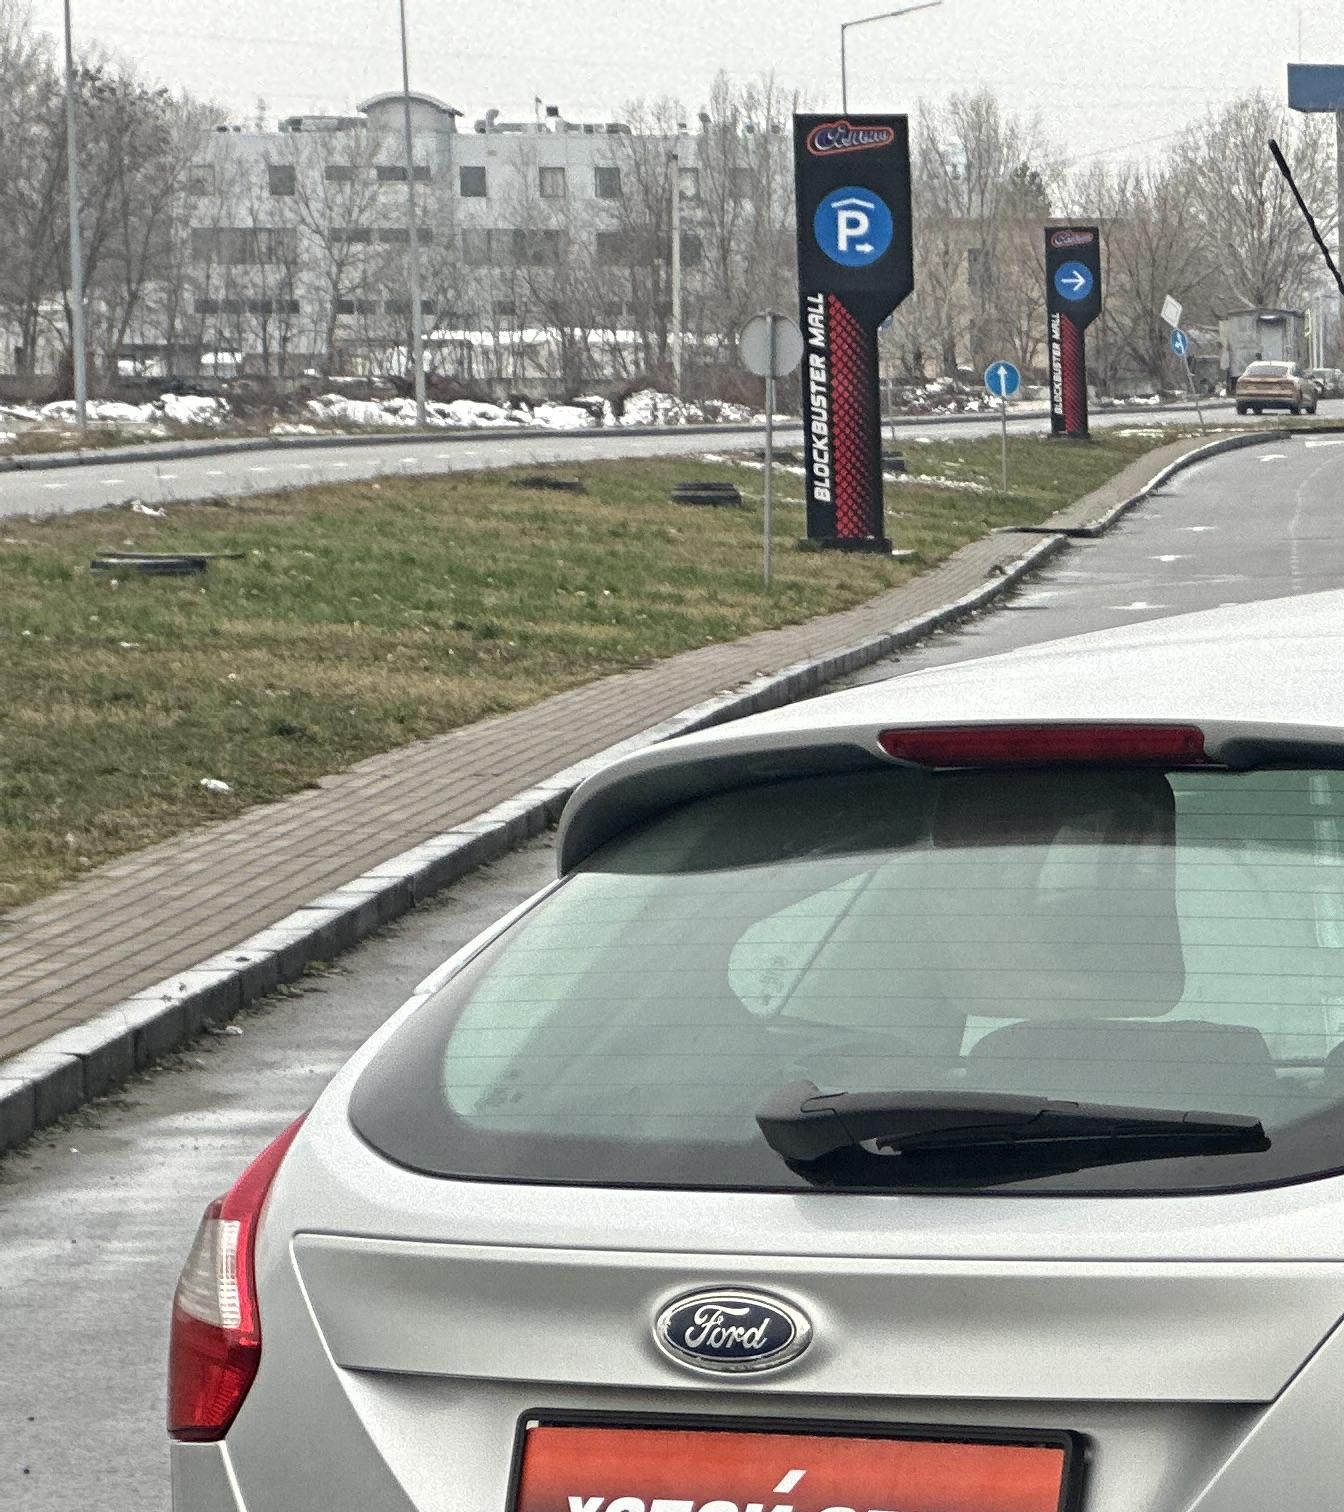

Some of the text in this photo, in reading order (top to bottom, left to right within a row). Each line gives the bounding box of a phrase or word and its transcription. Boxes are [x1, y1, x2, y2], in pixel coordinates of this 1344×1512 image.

[837, 209, 870, 252] P
[807, 292, 831, 502] BLOCKBUSTER MALL
[684, 1303, 771, 1351] Ford
